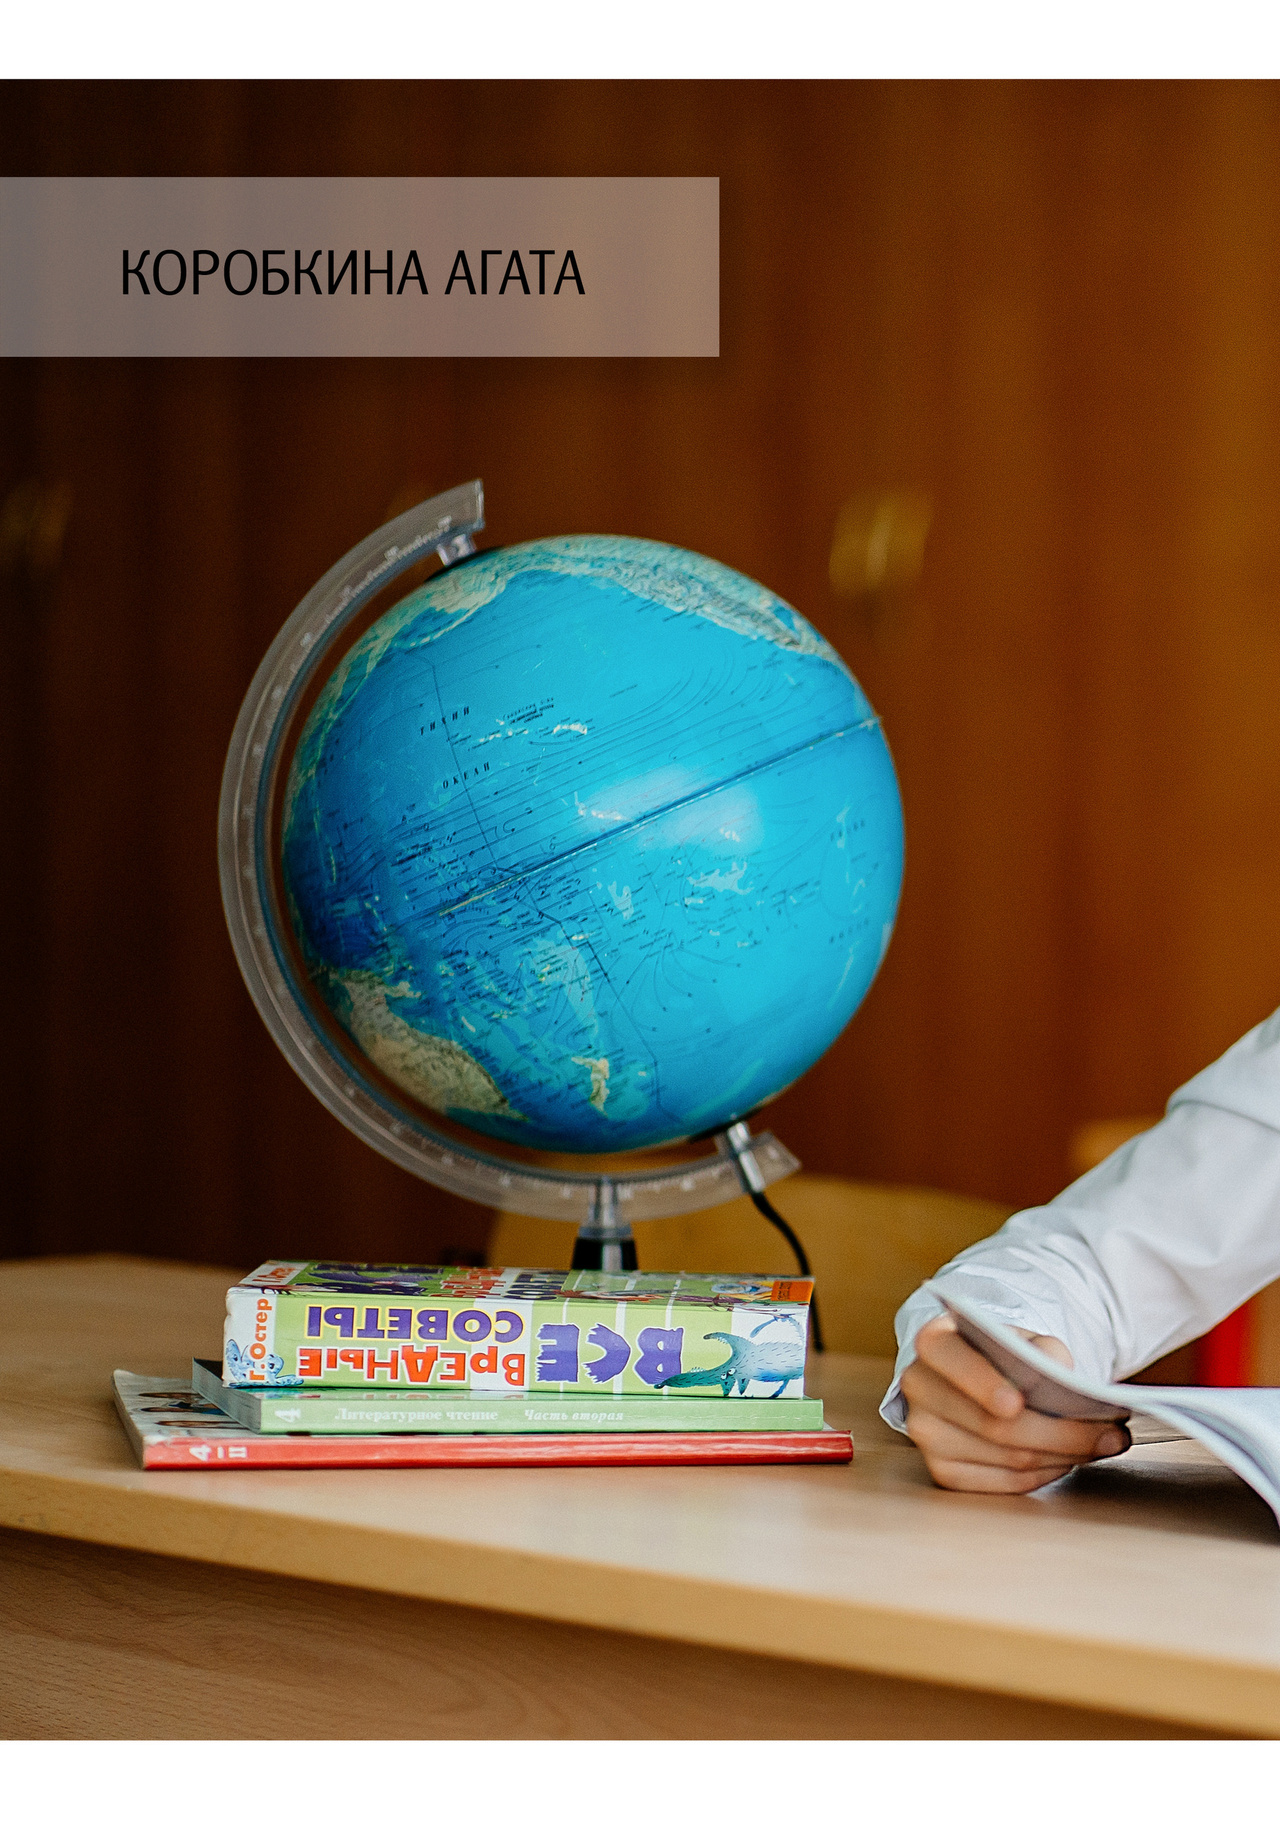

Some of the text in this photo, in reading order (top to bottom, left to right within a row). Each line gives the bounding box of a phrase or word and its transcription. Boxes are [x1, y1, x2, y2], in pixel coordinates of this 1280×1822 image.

[306, 1305, 525, 1343] СОВЕТЫ
[536, 1322, 684, 1385] ВСЕ
[334, 1408, 499, 1422] Литературное чтение
[523, 1408, 625, 1423] Часть вторая
